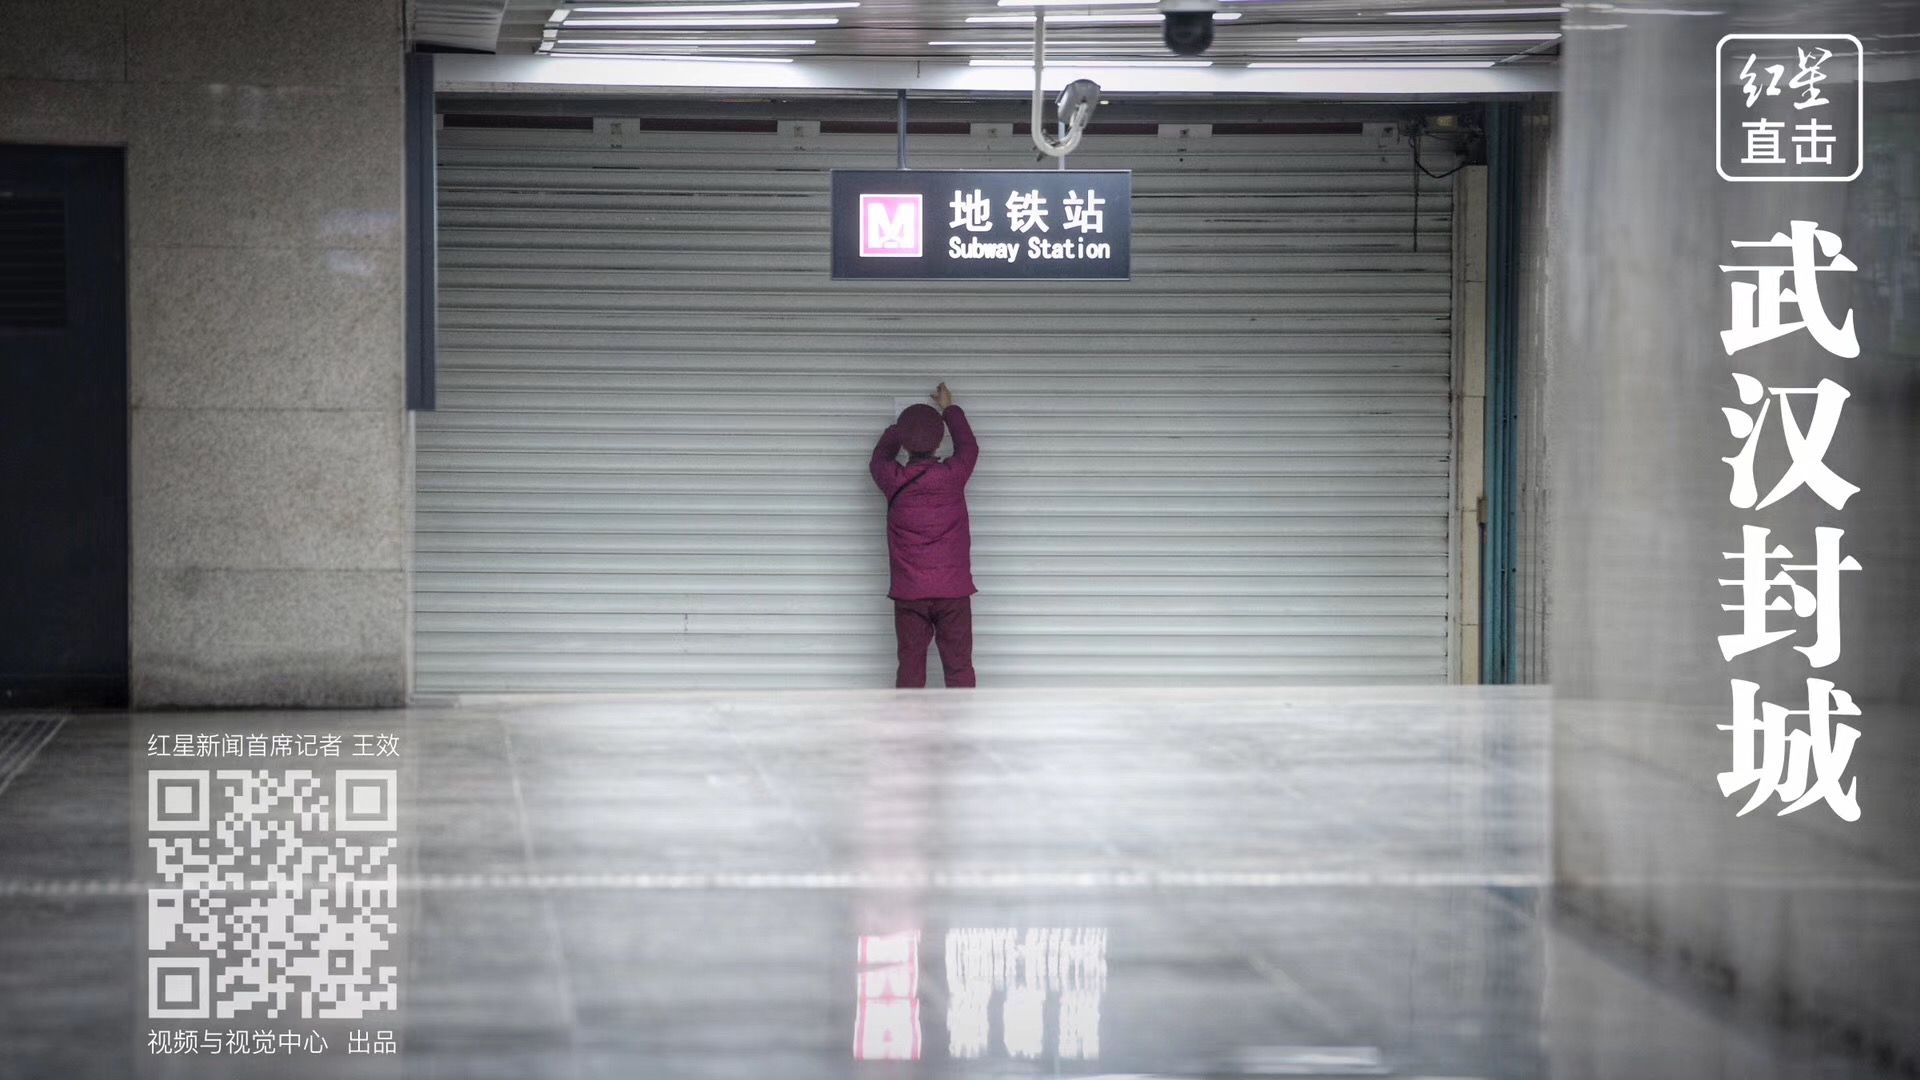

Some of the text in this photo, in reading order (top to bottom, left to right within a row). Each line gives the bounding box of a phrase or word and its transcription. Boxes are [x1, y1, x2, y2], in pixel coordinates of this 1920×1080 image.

[949, 189, 1106, 233] 地铁站
[949, 236, 1111, 262] Subway Station
